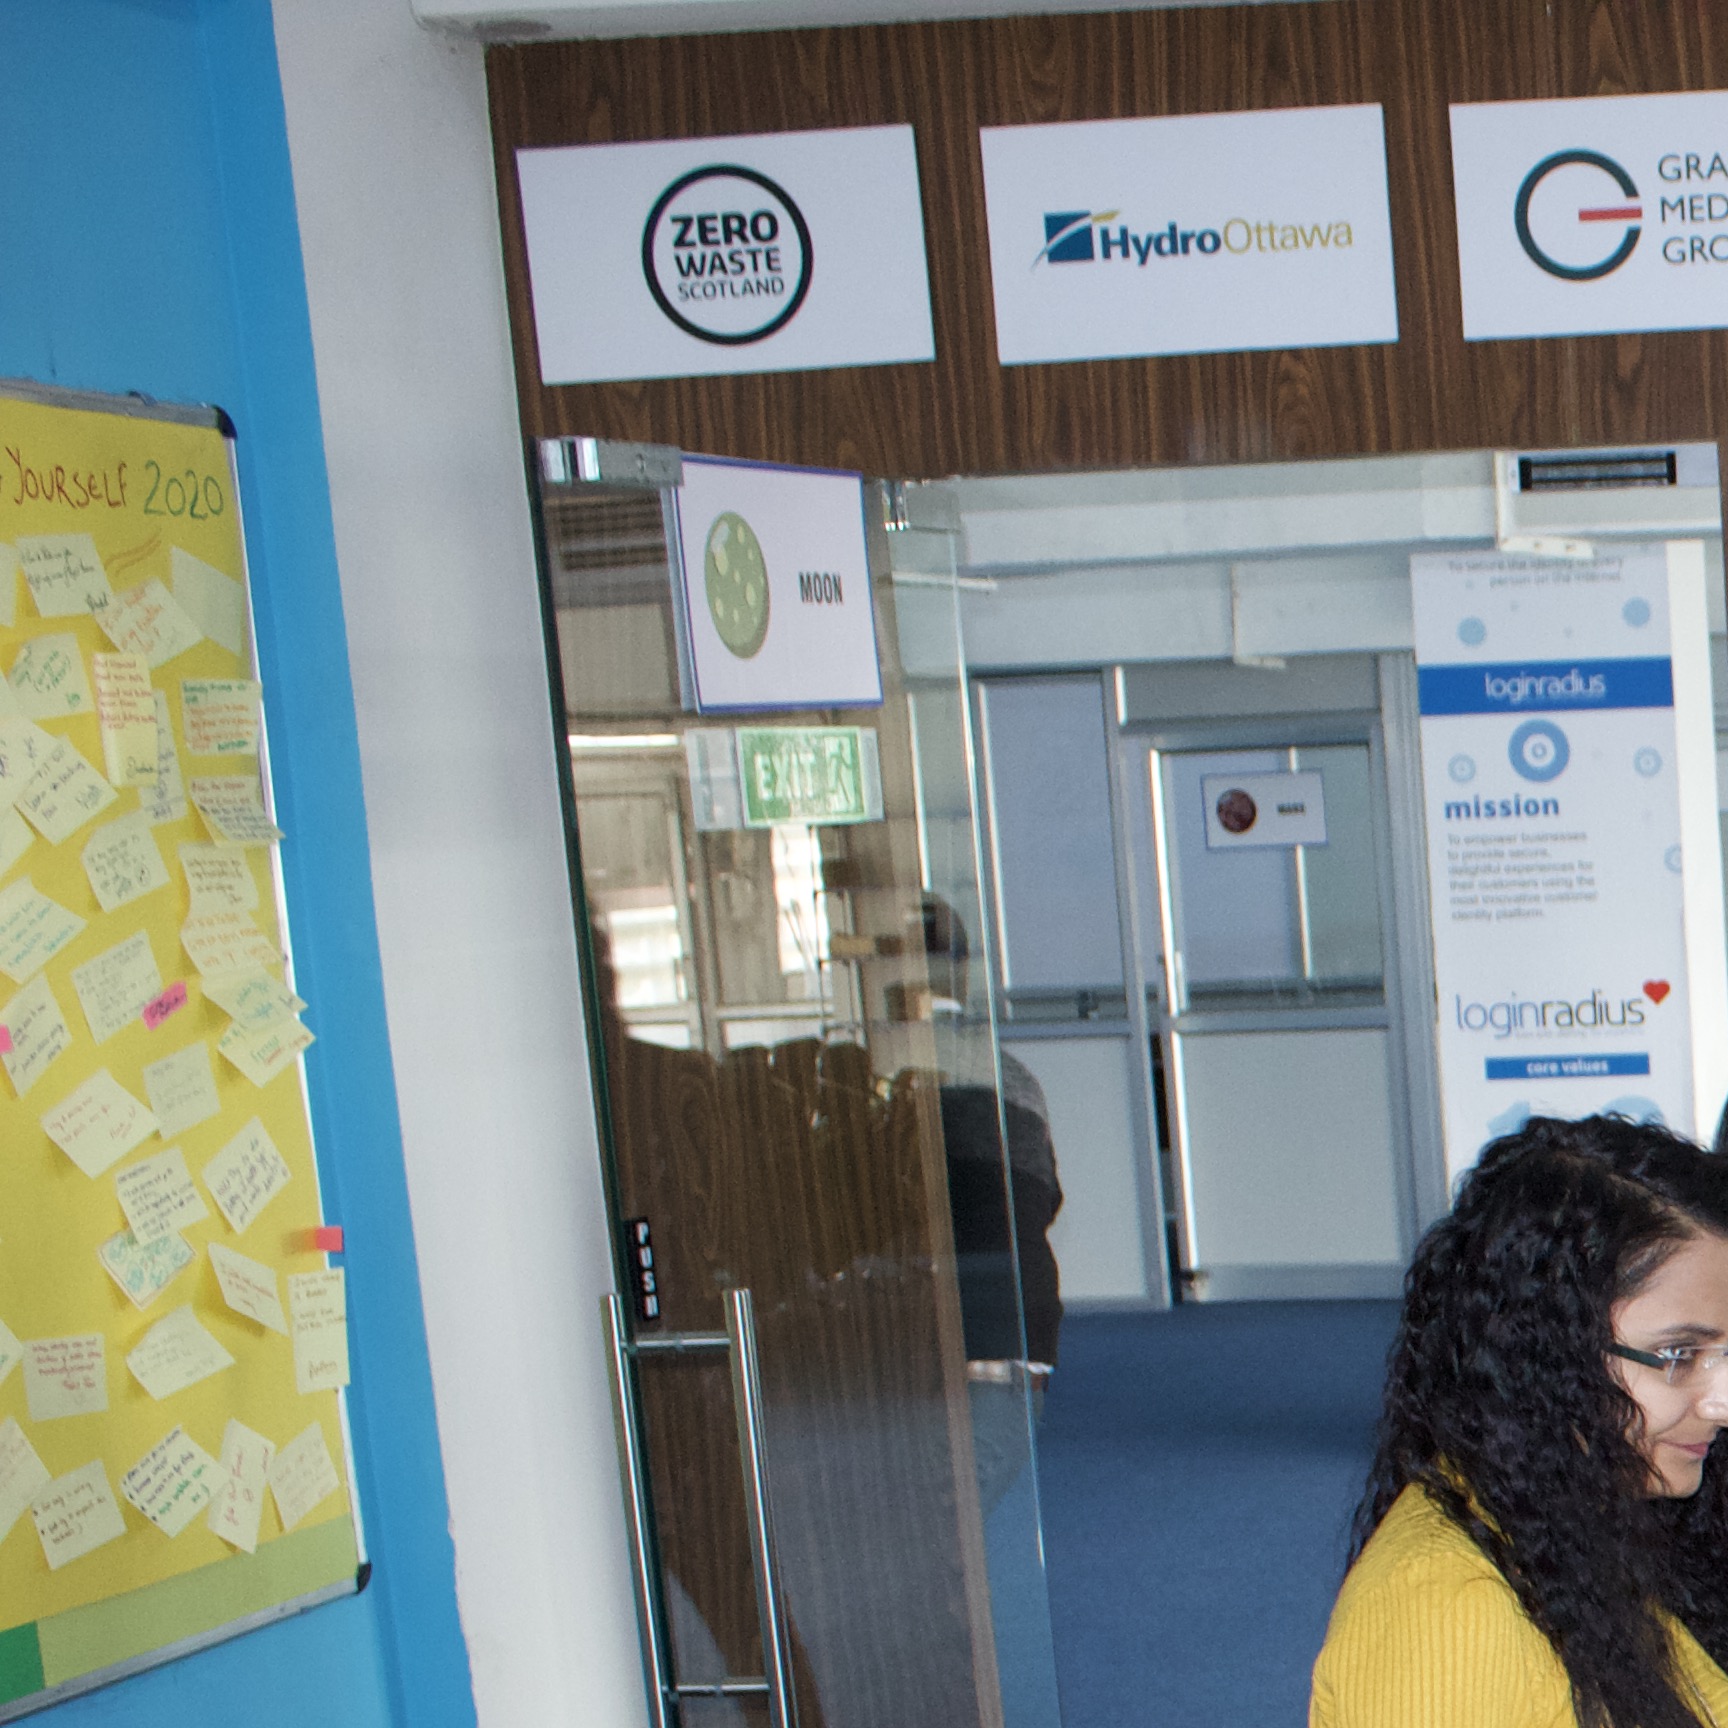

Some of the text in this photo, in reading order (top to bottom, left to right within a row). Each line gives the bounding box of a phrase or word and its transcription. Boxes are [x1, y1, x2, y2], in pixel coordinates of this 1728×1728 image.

[670, 209, 779, 248] ZERO
[674, 247, 782, 277] WASTE
[677, 276, 785, 301] SCOTLAND
[144, 460, 224, 521] 2020
[798, 570, 843, 604] MOON
[1484, 668, 1607, 703] loginradius
[754, 749, 816, 801] EXIT
[1444, 793, 1560, 820] mission
[1456, 988, 1645, 1040] loginradius
[1526, 1058, 1610, 1076] core values
